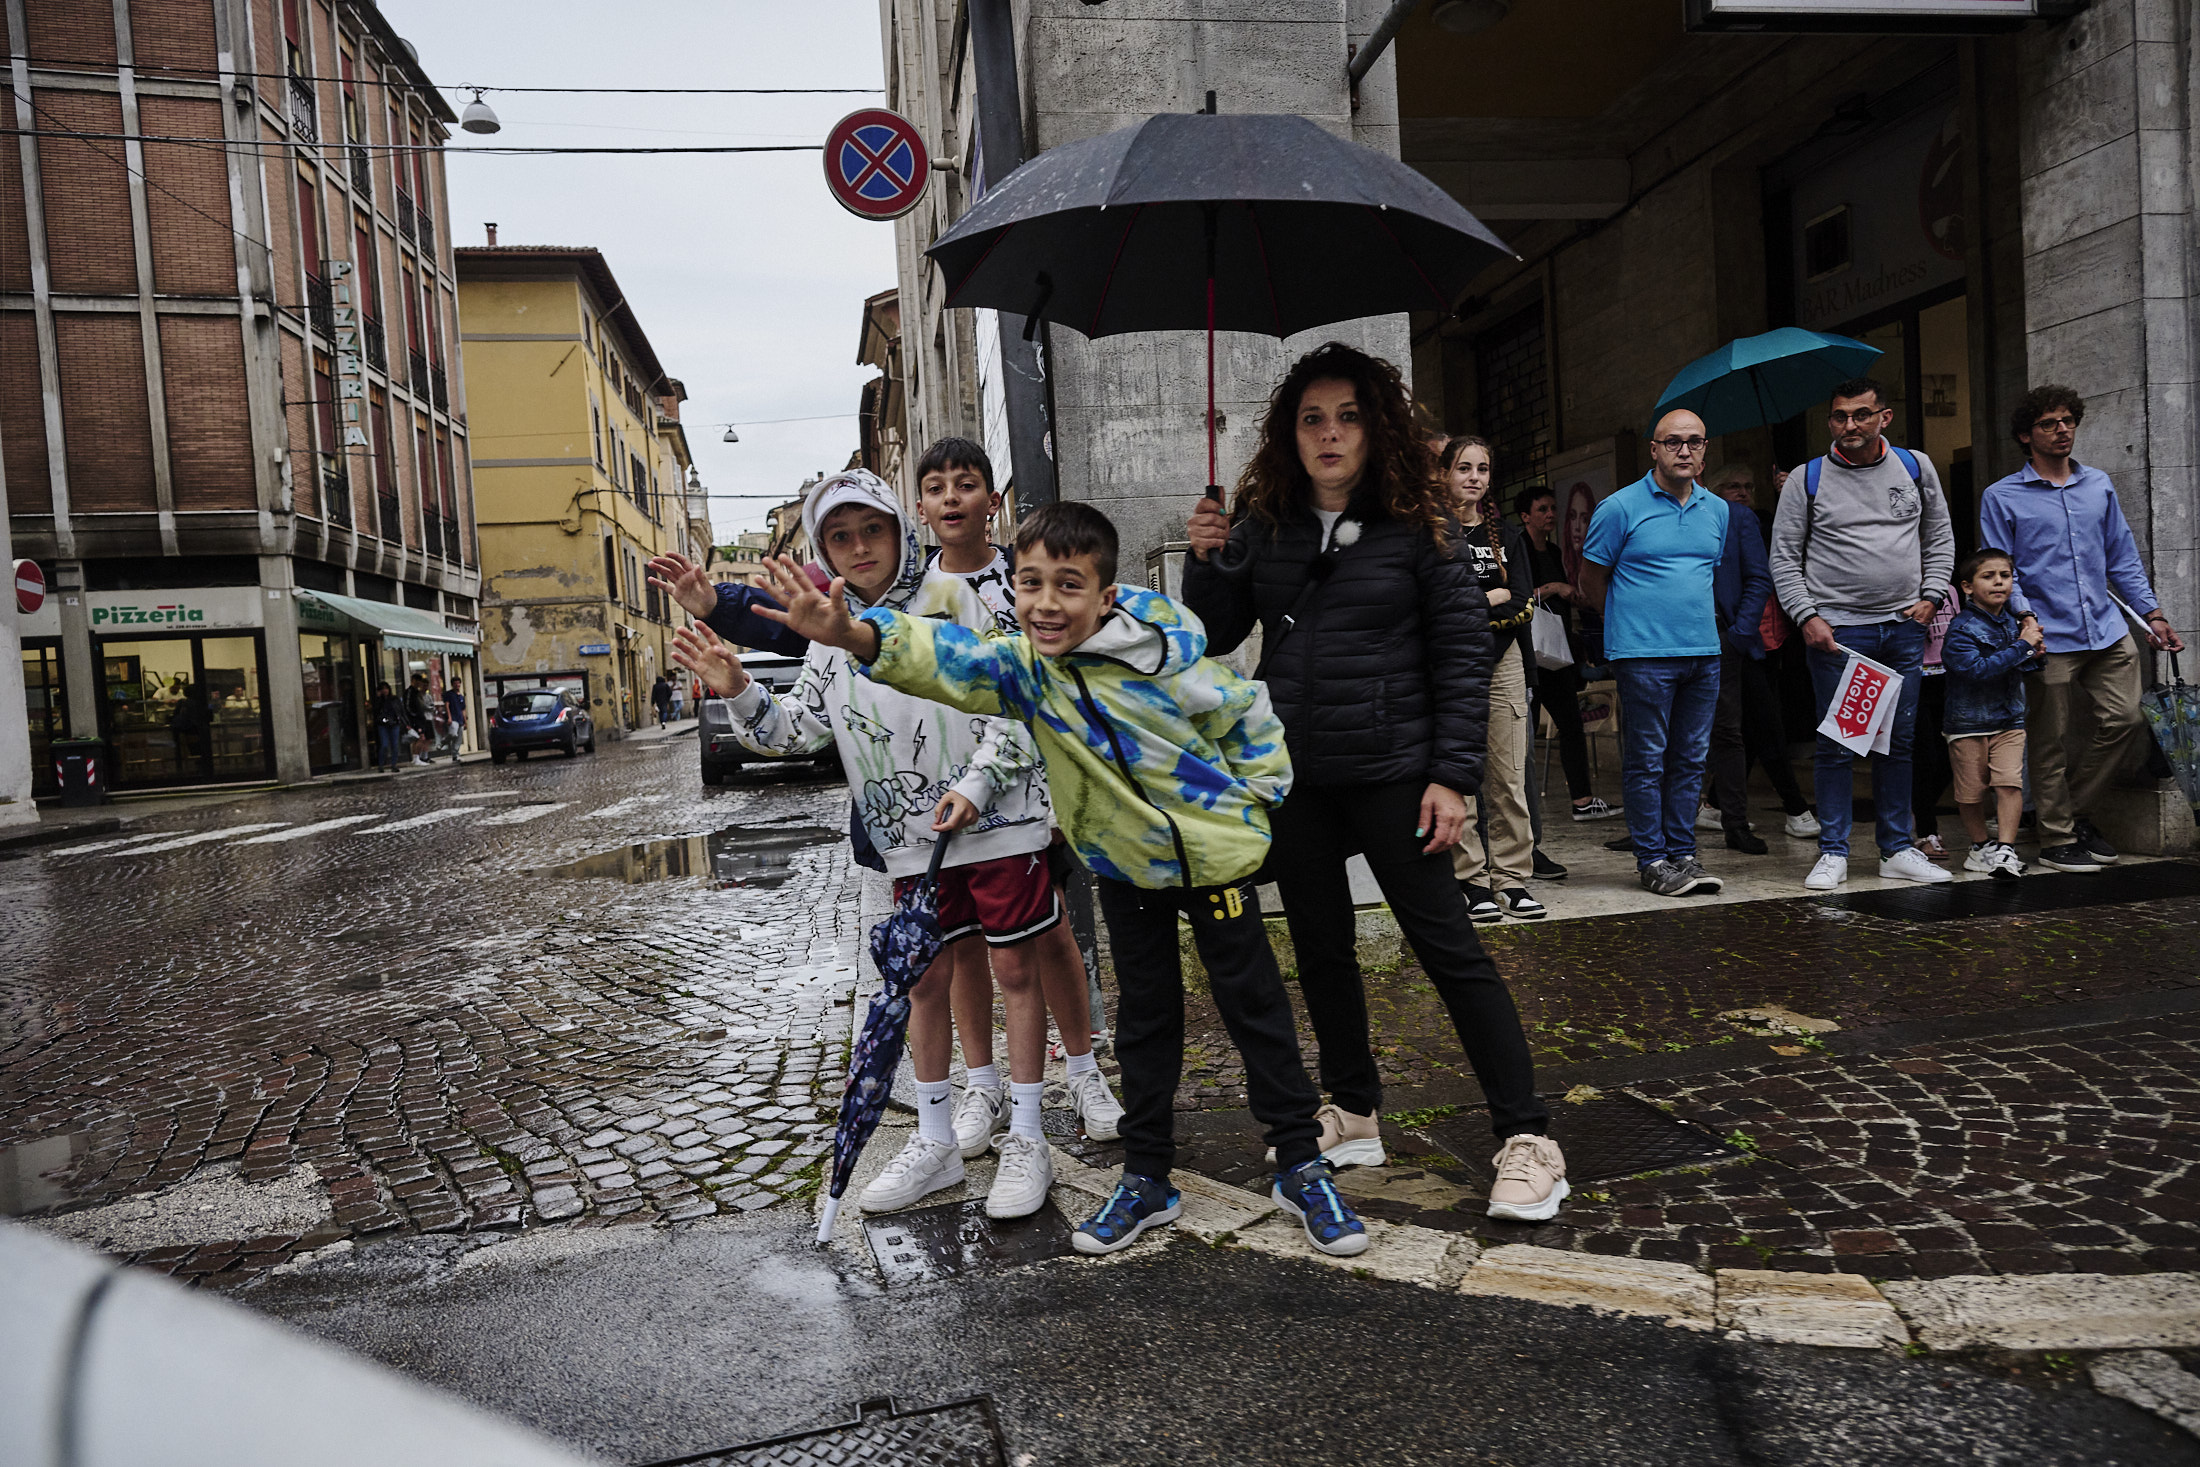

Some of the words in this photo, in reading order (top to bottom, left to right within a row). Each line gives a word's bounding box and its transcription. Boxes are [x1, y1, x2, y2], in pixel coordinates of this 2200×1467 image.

[1801, 288, 1841, 324] BAR
[1845, 260, 1928, 307] Madness
[331, 260, 368, 446] PIZZERIA
[92, 604, 204, 625] Pizzeria
[1839, 666, 1869, 720] MIGLIA
[1856, 679, 1882, 724] 1000
